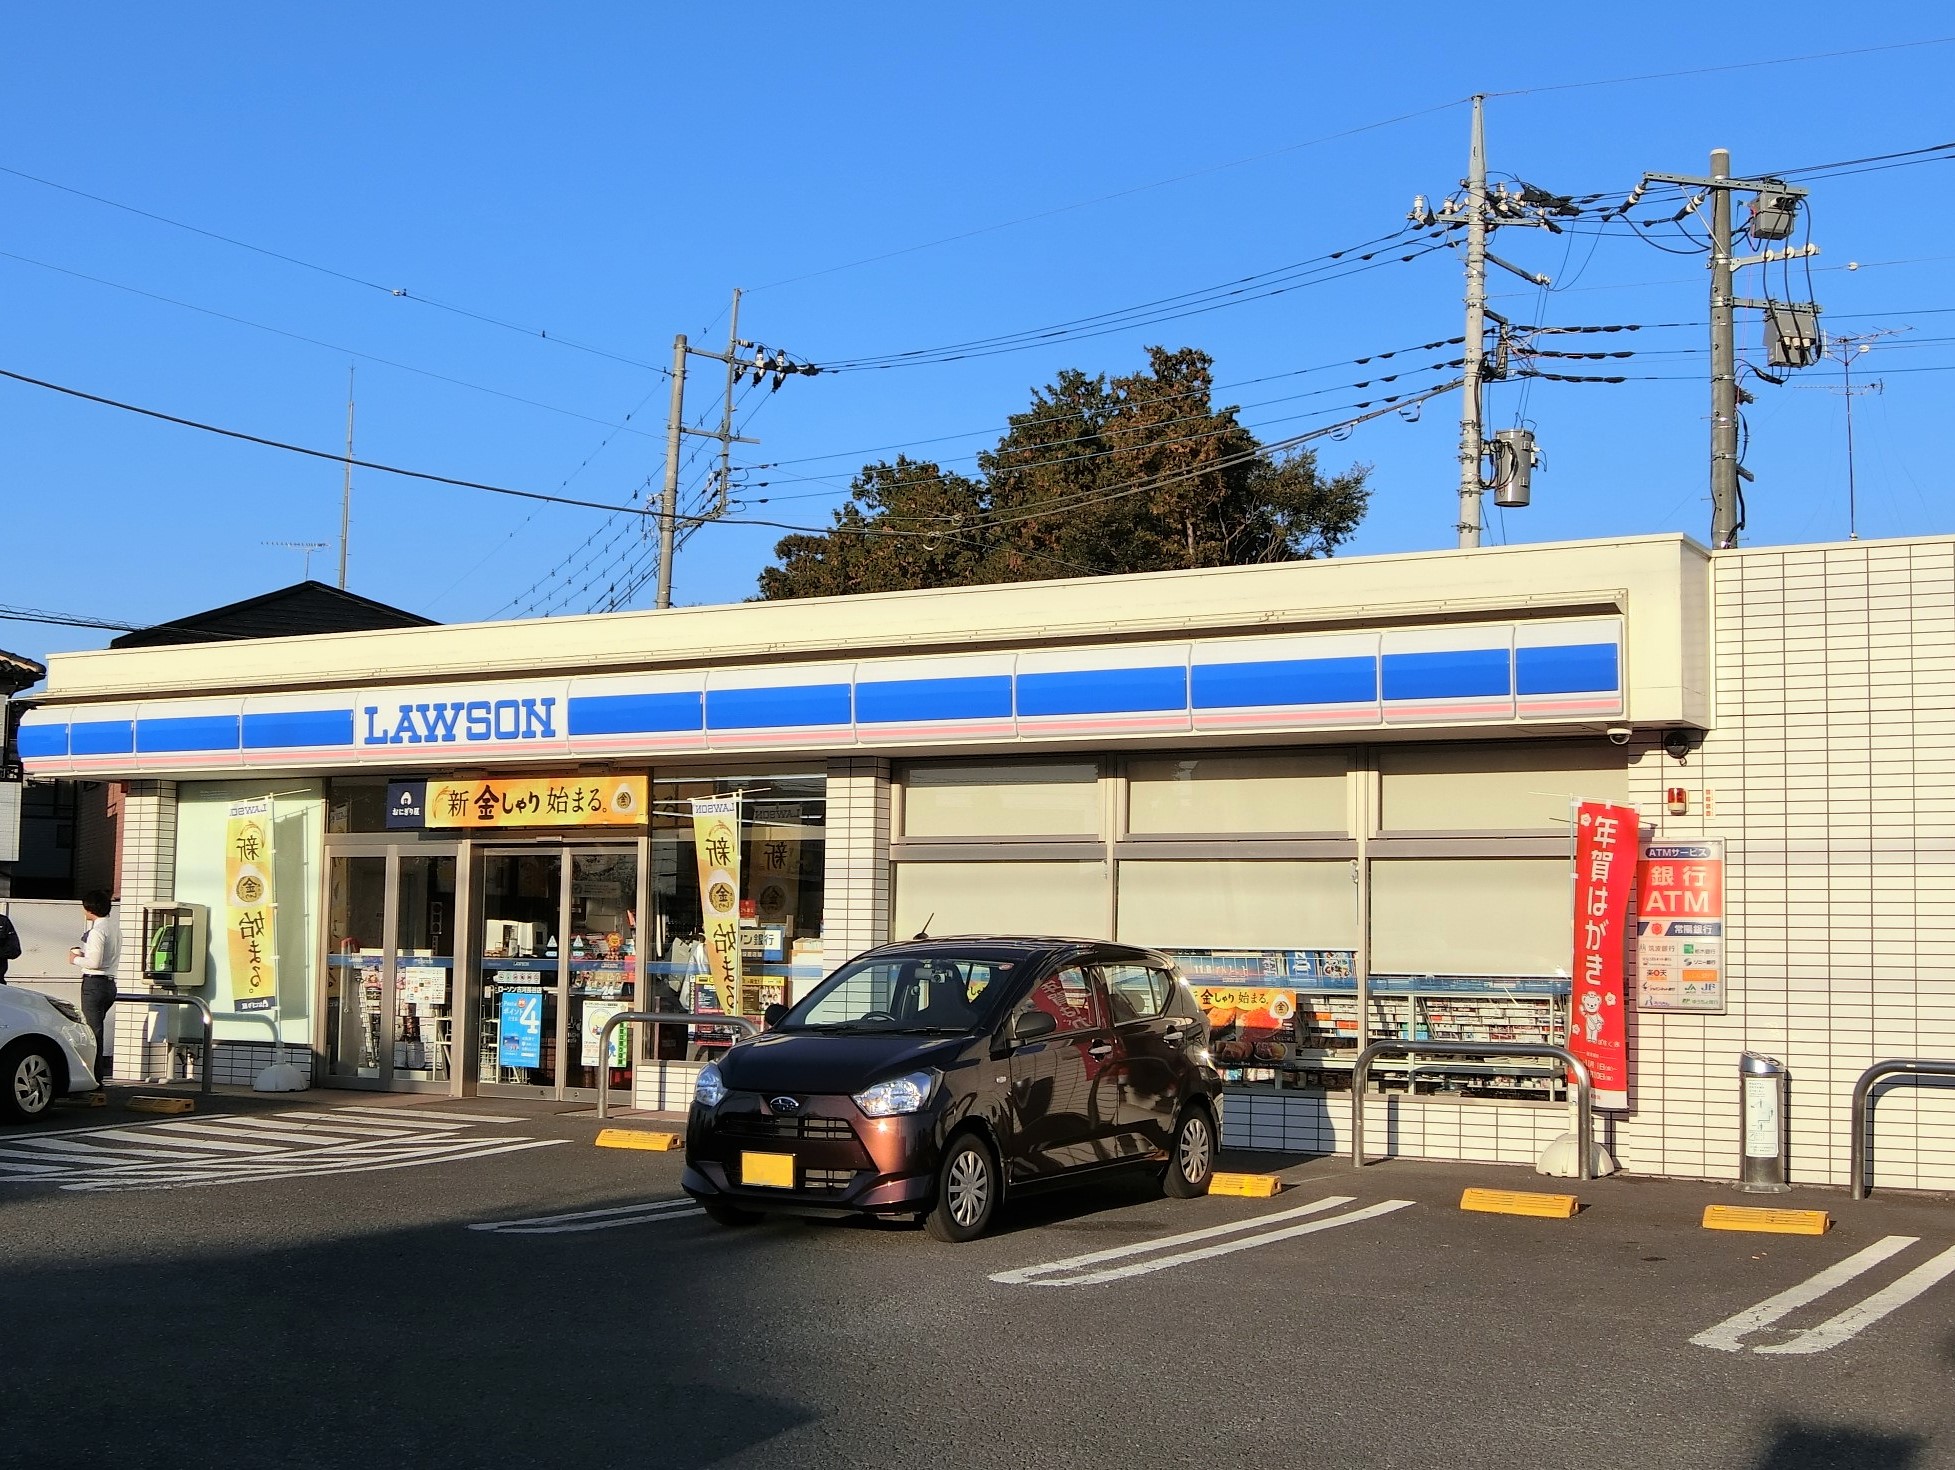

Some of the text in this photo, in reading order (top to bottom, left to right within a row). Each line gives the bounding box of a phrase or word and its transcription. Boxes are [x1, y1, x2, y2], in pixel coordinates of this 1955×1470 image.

[364, 697, 556, 745] LAWSON
[448, 790, 469, 817] 新
[474, 784, 541, 821] 金しゃり
[1648, 847, 1707, 858] ATMサービス
[1651, 865, 1707, 887] 銀行
[1584, 815, 1619, 986] 年賀はがき
[1645, 890, 1709, 913] ATM
